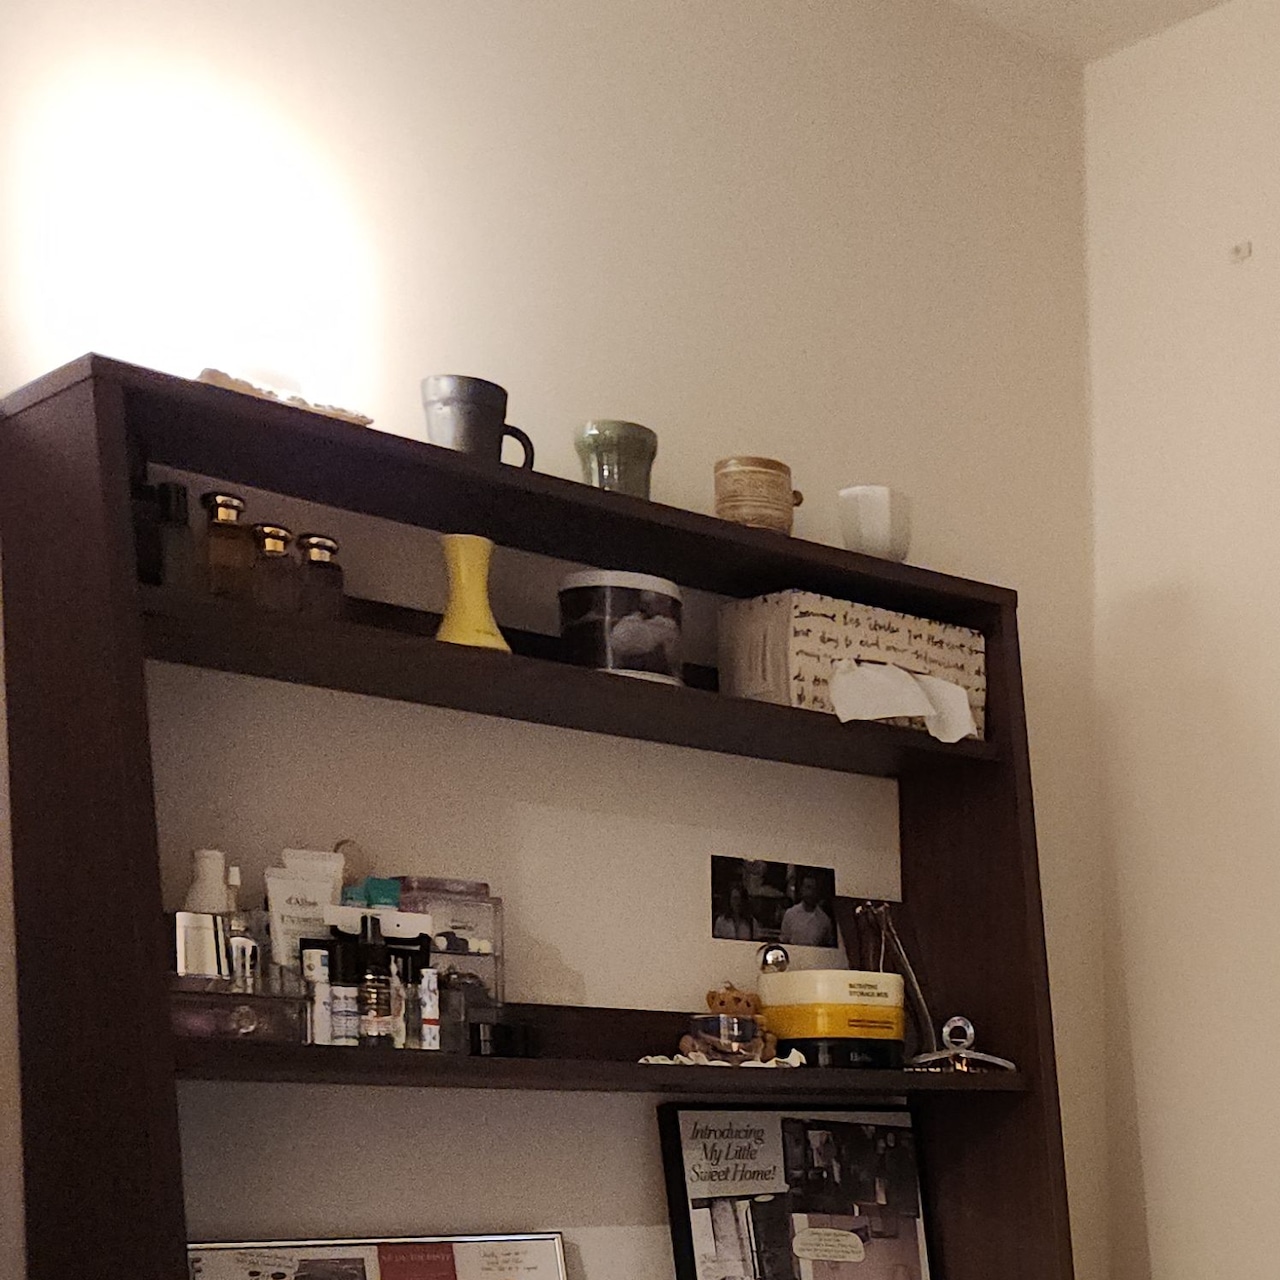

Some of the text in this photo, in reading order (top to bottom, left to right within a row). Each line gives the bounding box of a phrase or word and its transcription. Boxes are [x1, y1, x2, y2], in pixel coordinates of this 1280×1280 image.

[690, 1121, 765, 1144] Introducing
[701, 1142, 758, 1166] My Little
[690, 1164, 776, 1182] Sweet Home!
